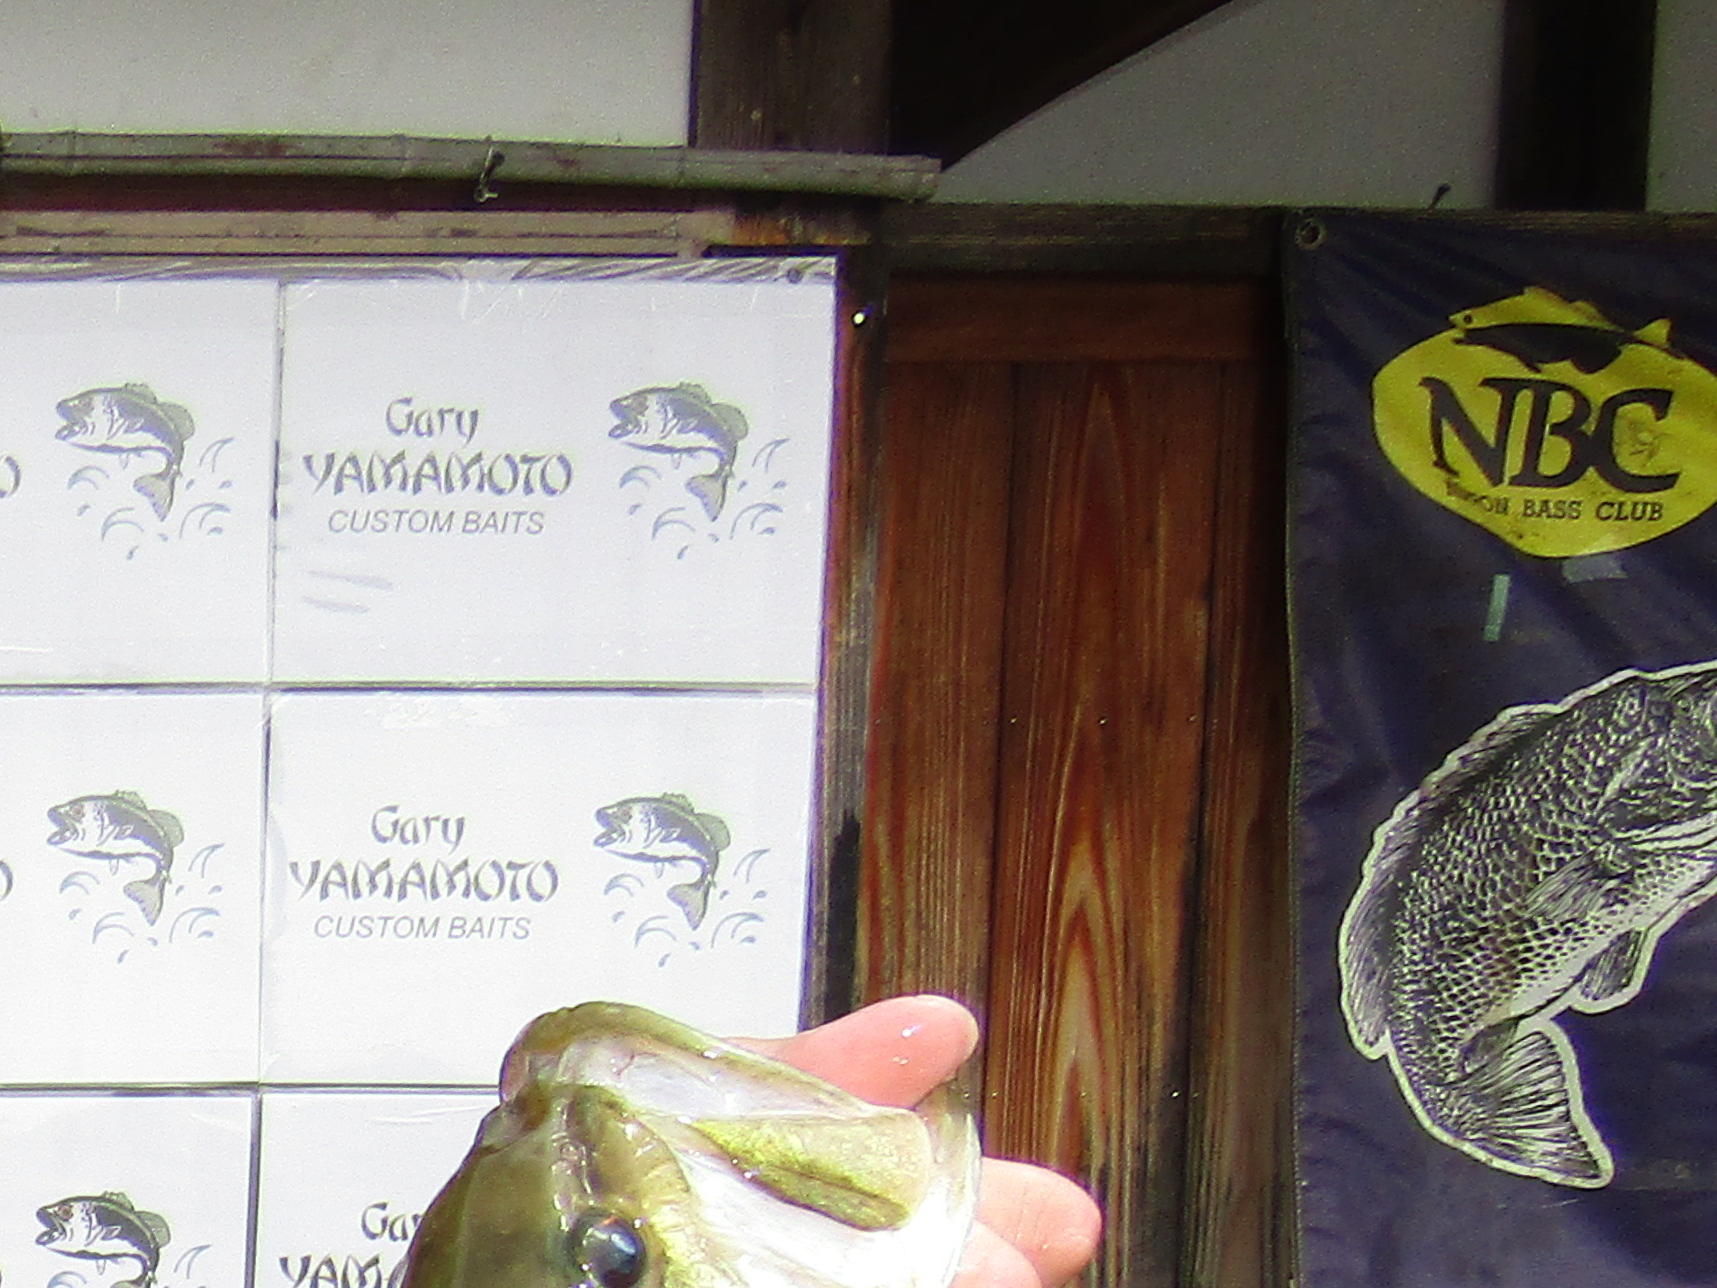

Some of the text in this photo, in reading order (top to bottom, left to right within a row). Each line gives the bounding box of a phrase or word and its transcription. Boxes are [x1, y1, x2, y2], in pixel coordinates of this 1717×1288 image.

[387, 397, 480, 448] Gary
[1418, 376, 1683, 494] NBC
[304, 451, 573, 497] YAMAMOTO
[329, 509, 546, 536] CUSTOM BAITS
[1522, 499, 1664, 522] BASS CLUB
[372, 805, 466, 852] Gary
[290, 857, 560, 903] YAMAMOTO
[315, 915, 532, 941] CUSTOM BAITS
